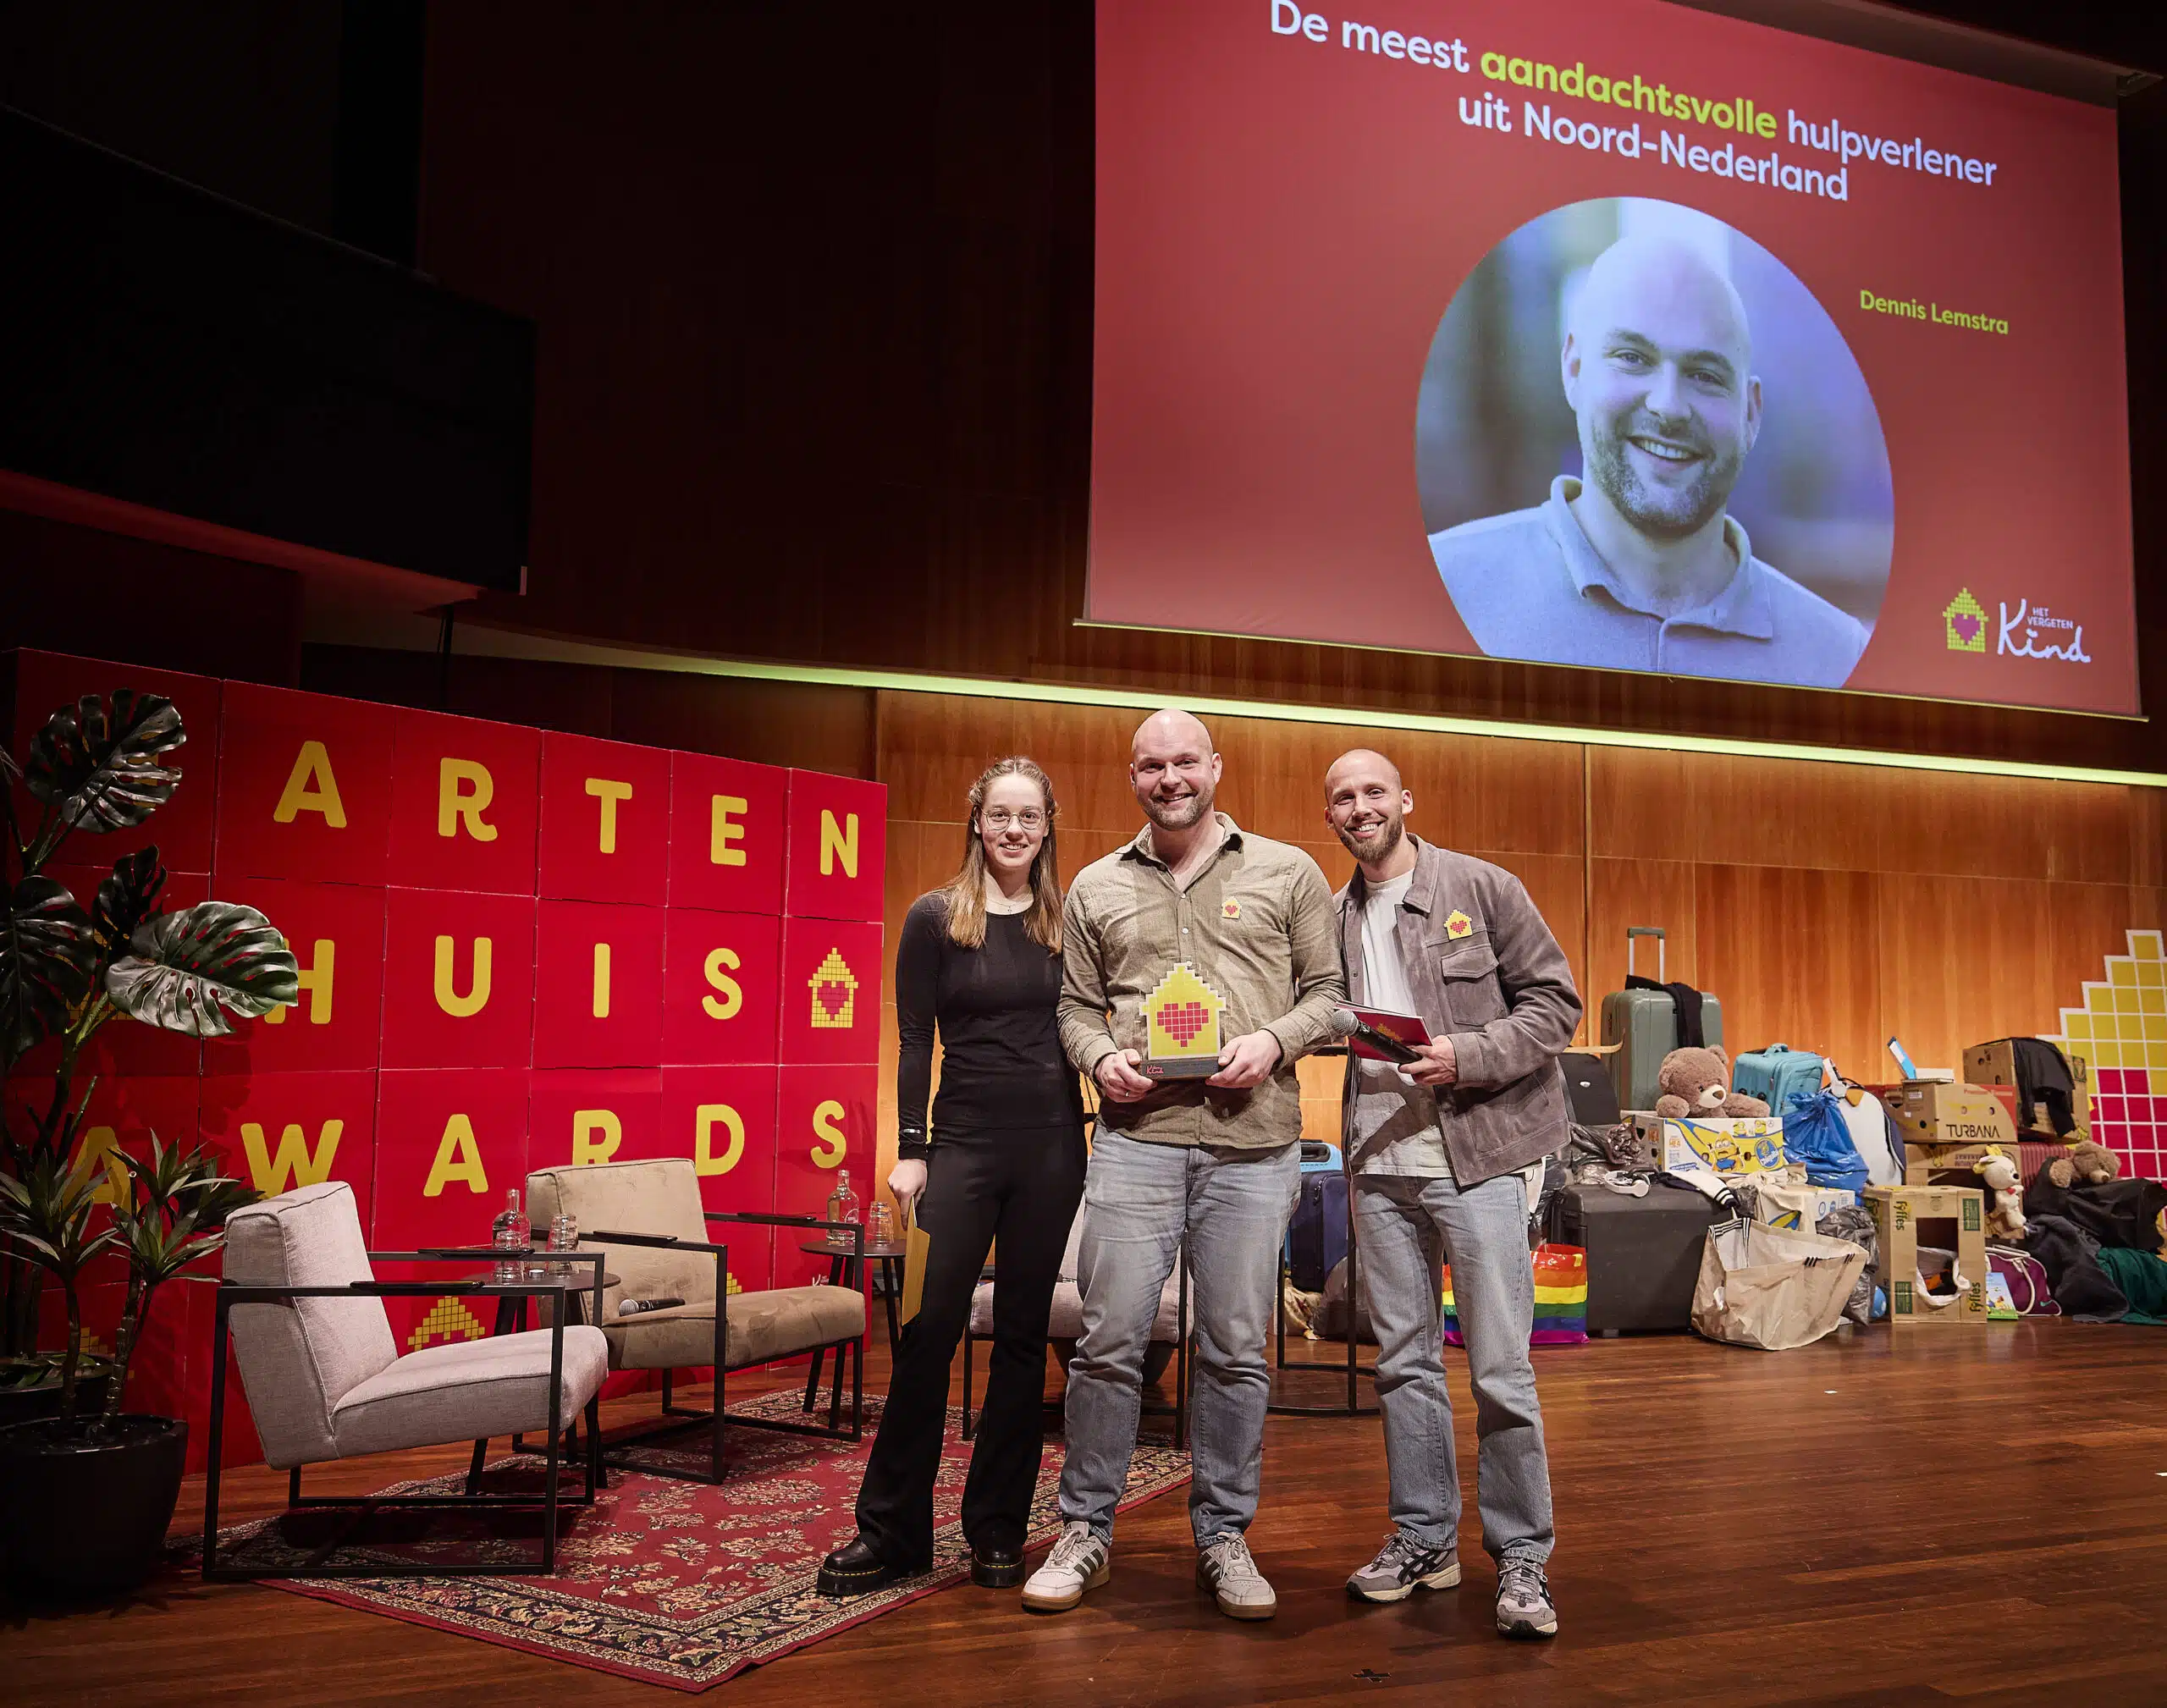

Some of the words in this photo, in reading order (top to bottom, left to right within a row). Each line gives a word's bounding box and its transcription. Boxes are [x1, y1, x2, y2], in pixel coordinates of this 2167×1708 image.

[1271, 0, 1329, 42] De
[1342, 20, 1470, 74] meest
[1480, 51, 1778, 139] aandachtsvolle
[1788, 108, 1997, 188] hulpverlener
[1458, 91, 1513, 133] uit
[1524, 101, 1848, 202] Noord-Nederland
[1860, 289, 1927, 320] Dennis
[1931, 303, 2009, 335] Lemstra
[1997, 598, 2092, 664] Kind
[2026, 615, 2073, 630] VERGETEN
[2032, 607, 2049, 618] HET
[1945, 1124, 2001, 1139] TURBANA
